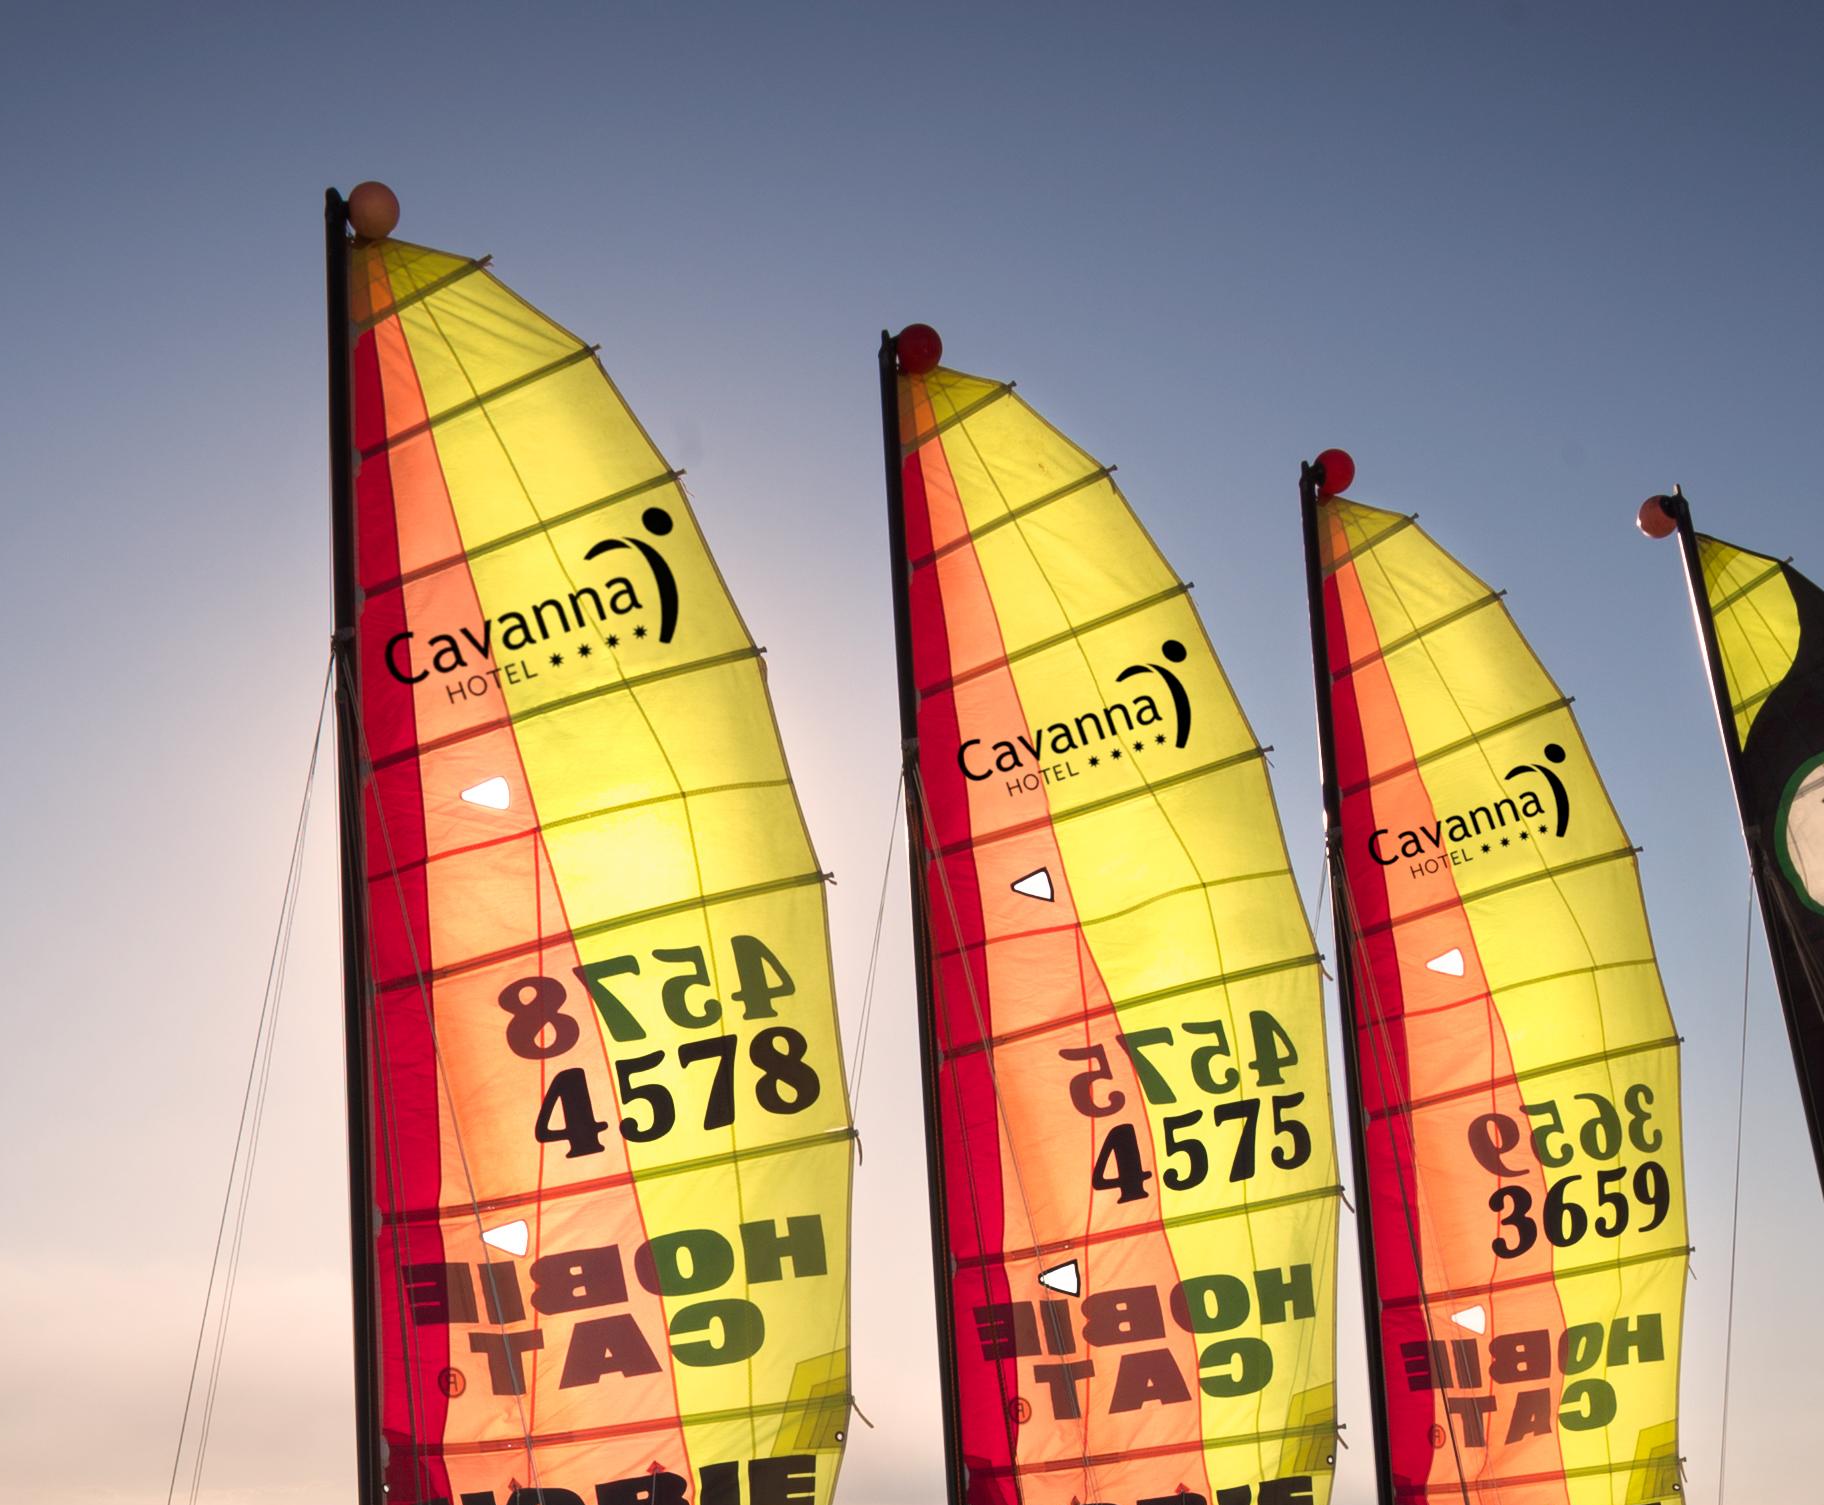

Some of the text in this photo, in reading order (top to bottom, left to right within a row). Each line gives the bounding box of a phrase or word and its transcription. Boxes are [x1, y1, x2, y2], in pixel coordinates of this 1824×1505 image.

[384, 575, 643, 685] Cavanna
[446, 659, 538, 705] HOTEL
[956, 694, 1163, 782] Cavanna
[1006, 763, 1080, 798] HOTEL
[1367, 790, 1545, 866] Cavanna
[1409, 850, 1474, 880] HOTEL
[534, 1025, 821, 1159] 4578
[1091, 1091, 1312, 1205] 4575
[1488, 1160, 1670, 1260] 3659
